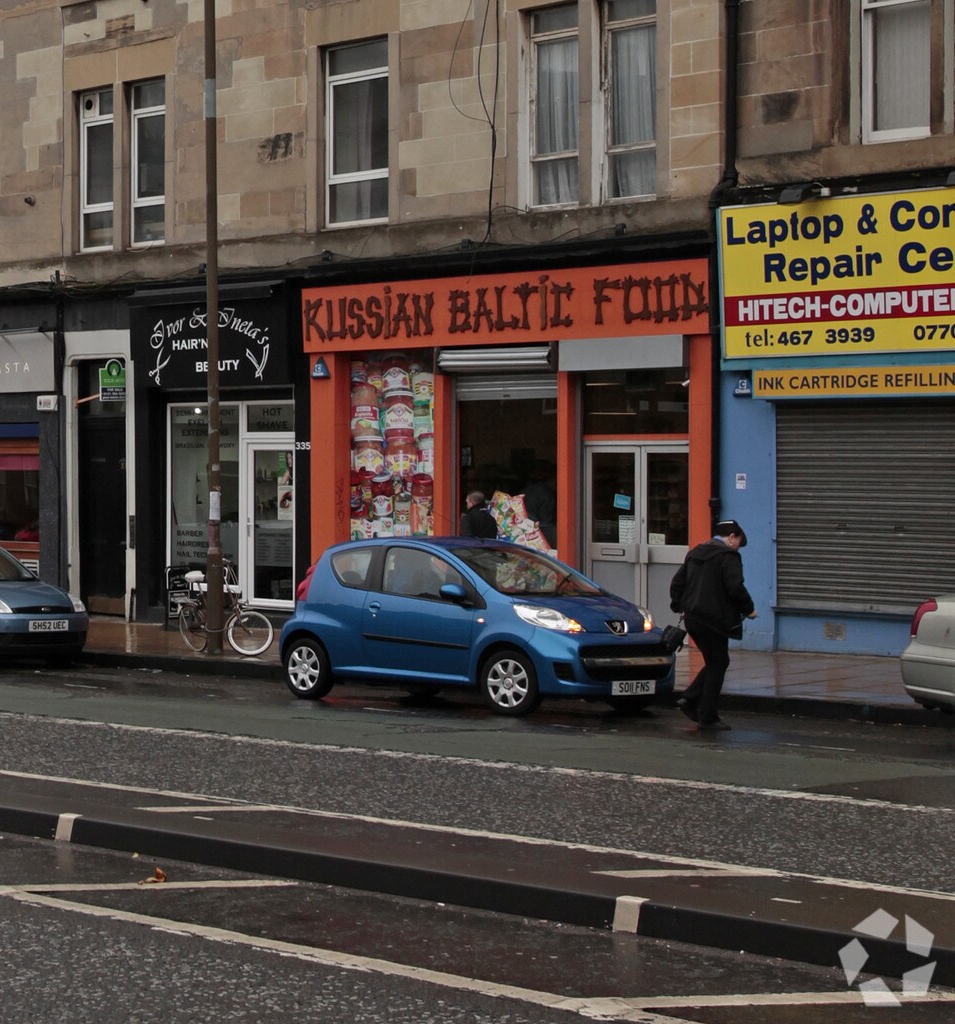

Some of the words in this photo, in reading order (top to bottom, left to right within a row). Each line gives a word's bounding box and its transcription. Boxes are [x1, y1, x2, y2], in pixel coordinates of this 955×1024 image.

[726, 211, 844, 248] Laptop
[857, 203, 878, 235] &
[764, 245, 882, 285] Repair
[189, 307, 208, 328] &
[777, 330, 813, 346] 467
[825, 327, 875, 343] 3939
[195, 359, 240, 372] BEUTY
[758, 376, 785, 390] INK
[789, 375, 880, 389] CARTRIDGE
[263, 408, 282, 416] HOT
[257, 421, 288, 429] SHAVE
[53, 621, 66, 629] UEC
[635, 682, 650, 692] FNS
